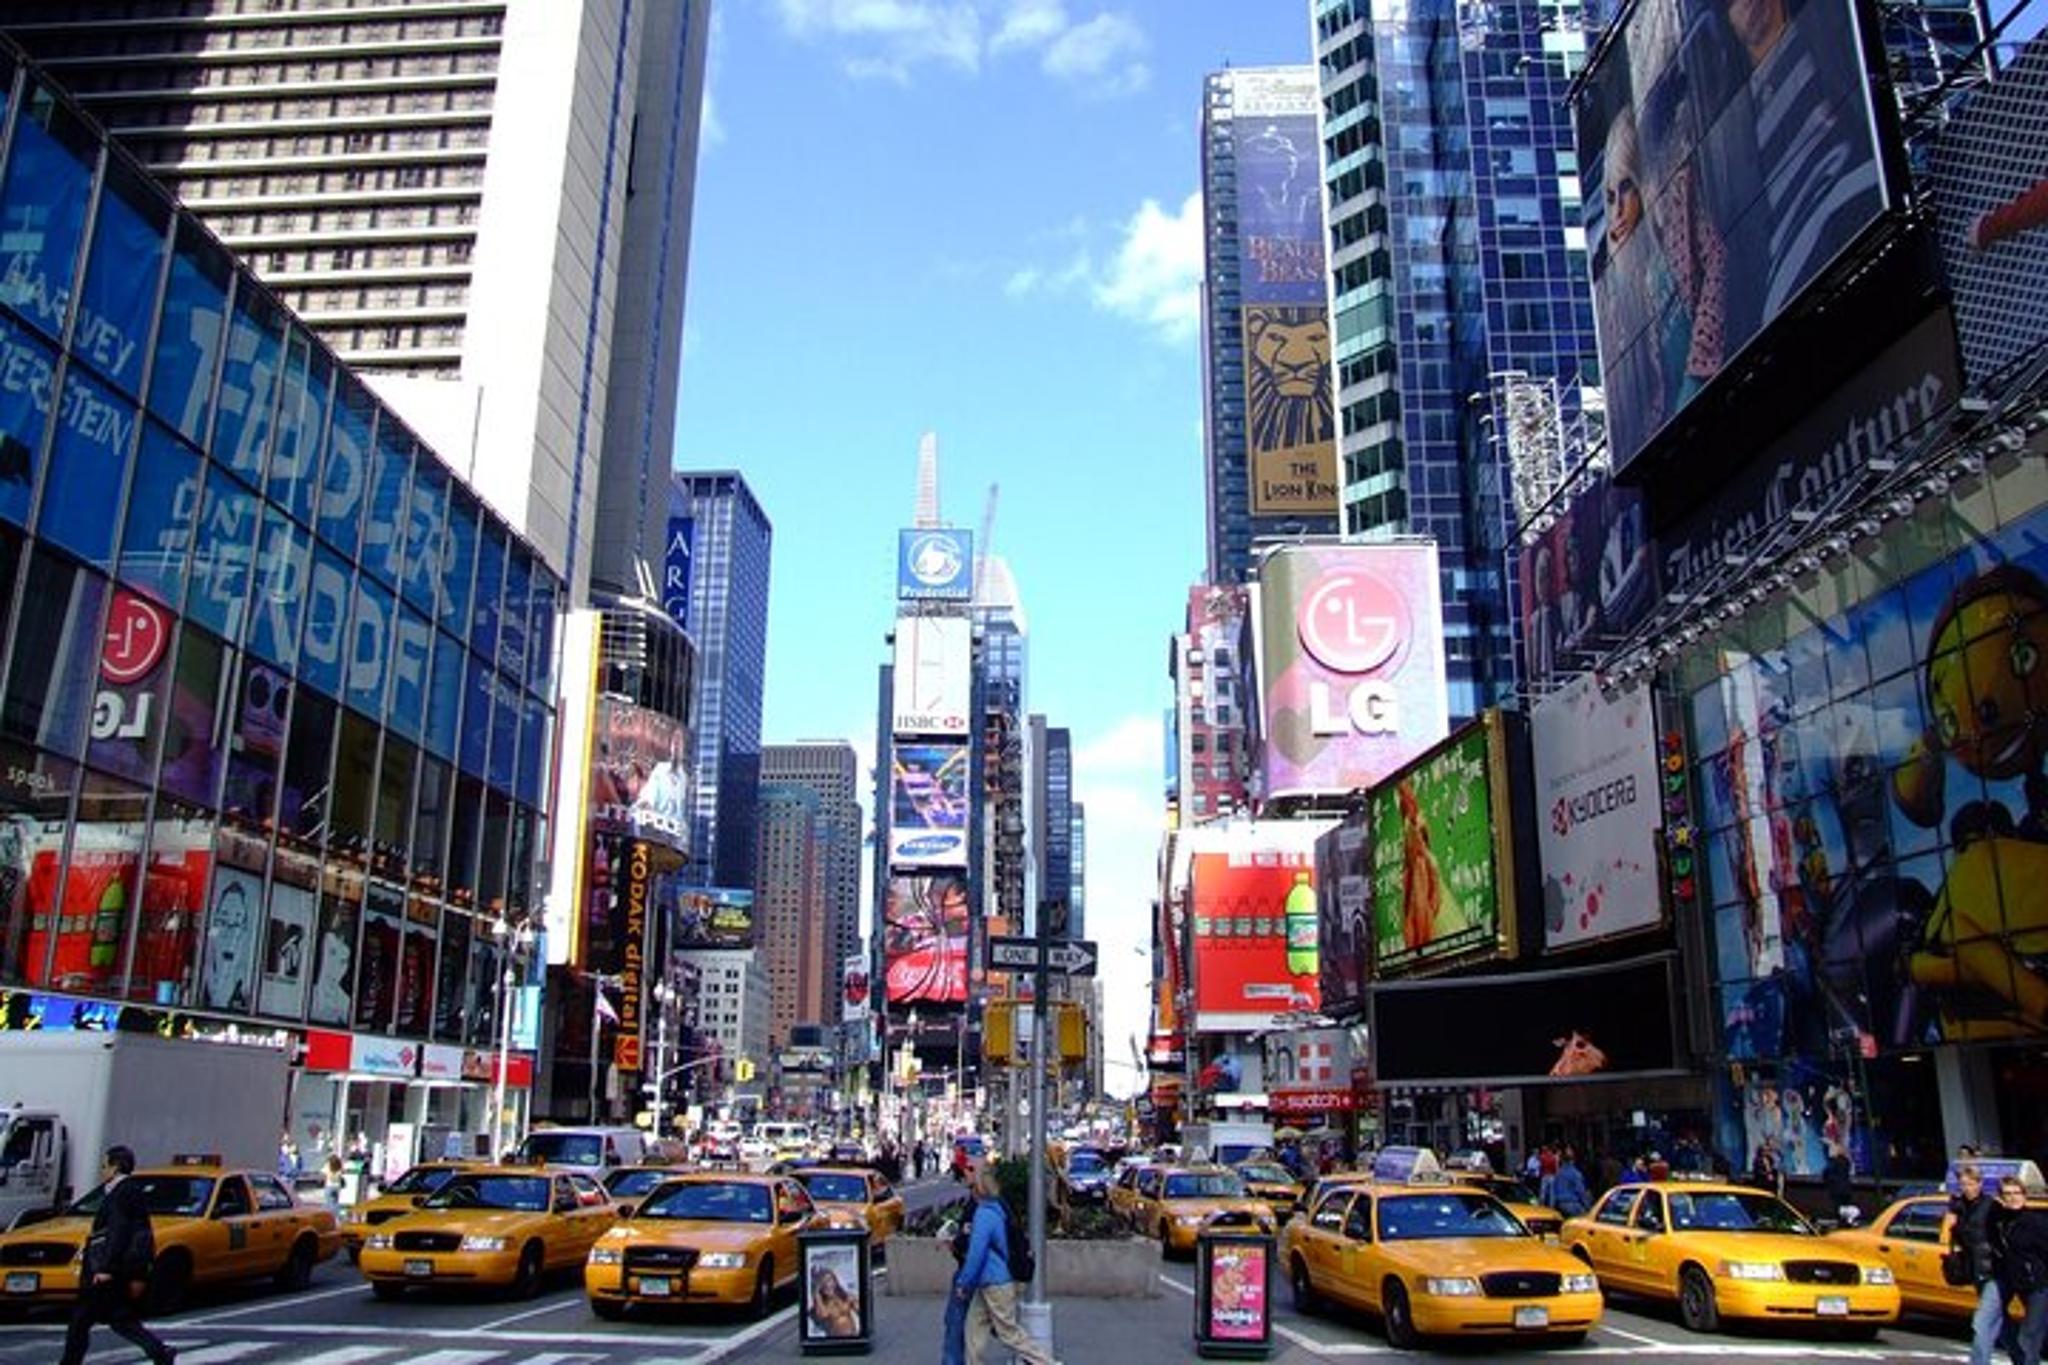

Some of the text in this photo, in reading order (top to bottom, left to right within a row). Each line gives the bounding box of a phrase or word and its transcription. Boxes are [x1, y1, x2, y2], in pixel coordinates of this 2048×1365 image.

[1288, 461, 1318, 476] THE
[1311, 681, 1401, 738] LG
[896, 714, 940, 729] HSBC
[627, 842, 649, 936] KODAK
[1003, 947, 1083, 963] ONE WAY
[1288, 1093, 1341, 1108] swatch
